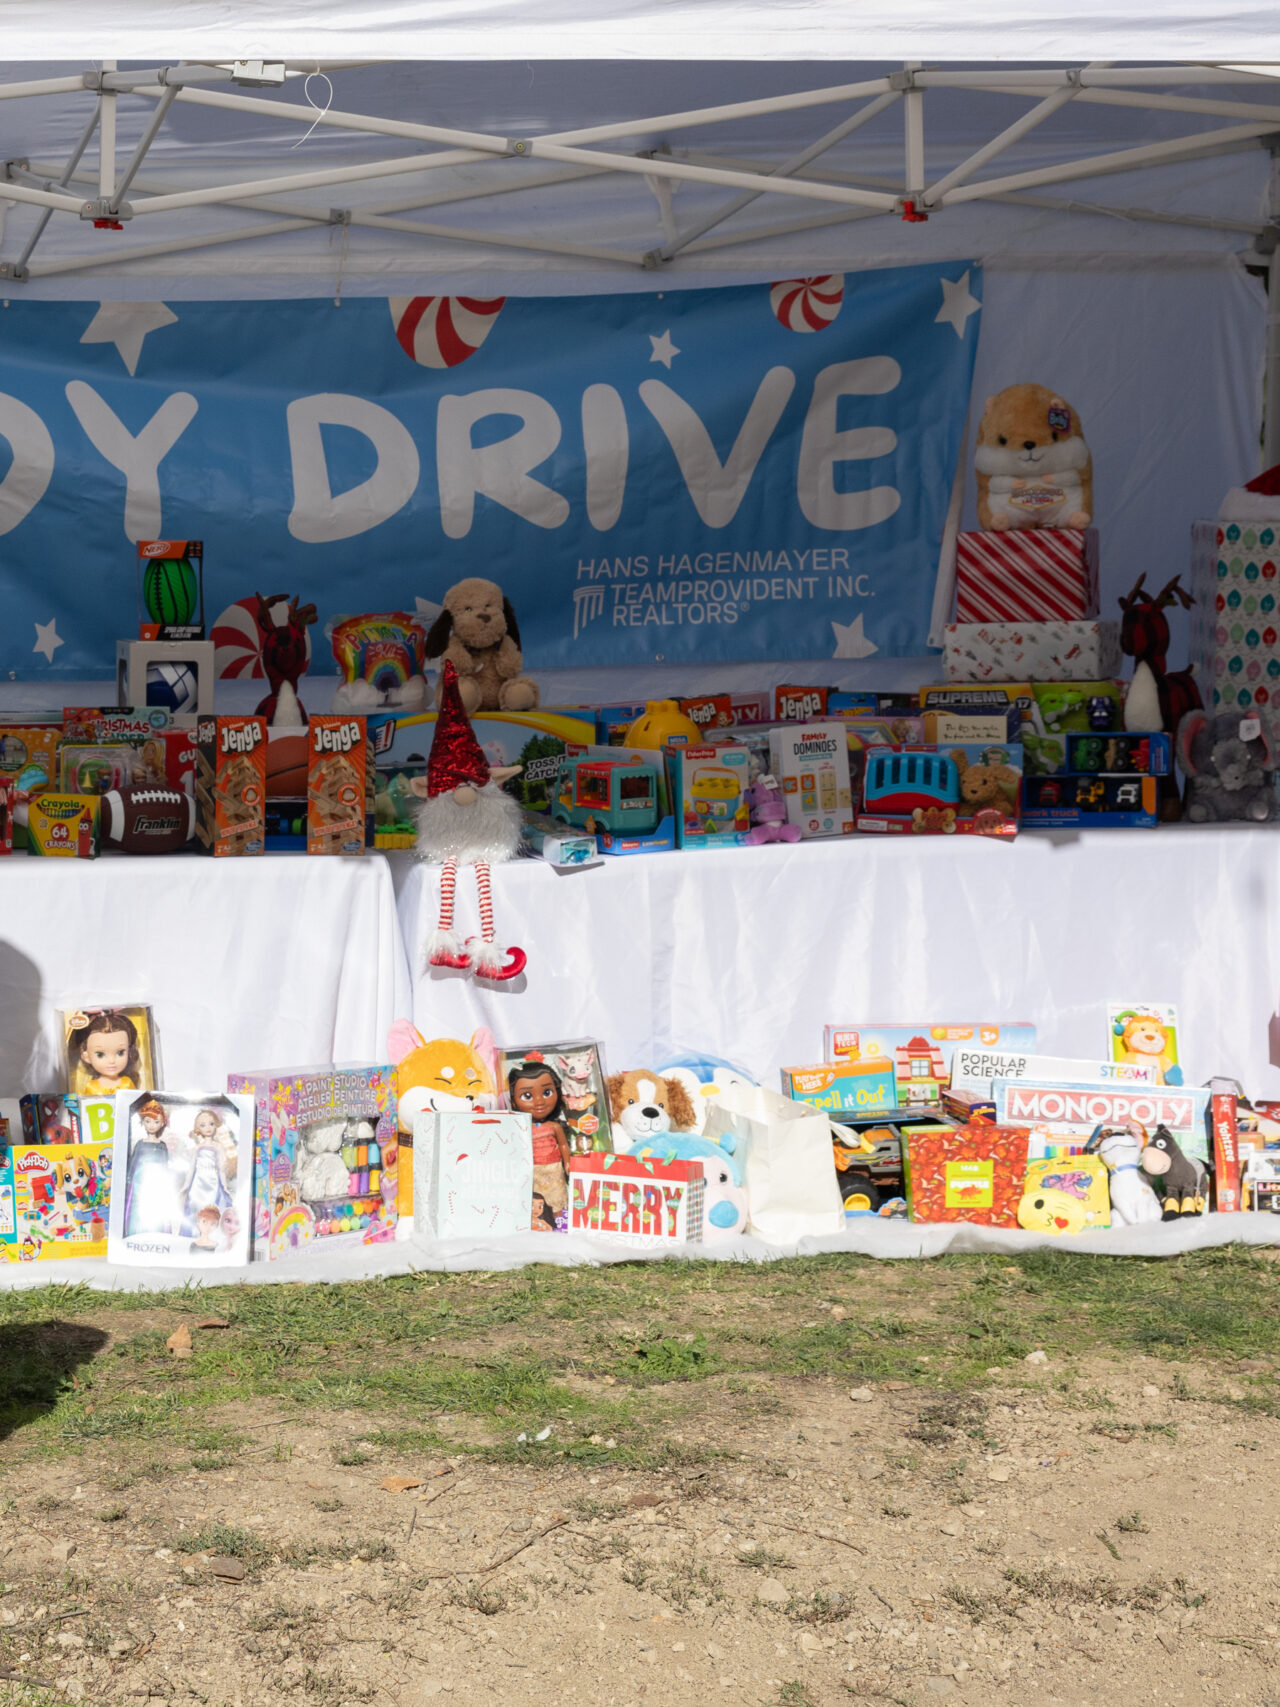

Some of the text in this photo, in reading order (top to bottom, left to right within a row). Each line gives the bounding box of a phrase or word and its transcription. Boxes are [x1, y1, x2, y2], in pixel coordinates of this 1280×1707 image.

[576, 548, 850, 580] HANS HAGENMAYER
[610, 574, 877, 605] TEAMPROVIDENT INC.
[926, 690, 1008, 704] SUPREME
[780, 693, 822, 721] Jenga
[221, 722, 263, 753] Jenga
[314, 721, 362, 753] Jenga
[802, 733, 827, 742] FAMILY
[794, 740, 837, 755] DOMINOES
[525, 767, 559, 781] CATCH
[529, 758, 556, 771] TOSS
[41, 799, 81, 811] Crayola
[51, 827, 68, 839] 64
[133, 815, 181, 834] Franklin
[45, 841, 77, 850] CRAYONS
[961, 1053, 1026, 1069] POPULAR
[962, 1065, 1025, 1077] SCIENCE
[1100, 1065, 1148, 1080] STEAM
[306, 1074, 367, 1094] PAINT STUDIO
[298, 1092, 331, 1111] ATELIER
[334, 1089, 377, 1102] PEINTURE
[856, 1085, 885, 1105] Out
[296, 1108, 331, 1126] ESTUDIO
[343, 1104, 380, 1117] PINTURA
[1011, 1091, 1193, 1127] MONOPOLY
[1217, 1121, 1235, 1162] Yahtzee
[572, 1178, 686, 1238] MERRY
[127, 1241, 171, 1254] FROZEN
